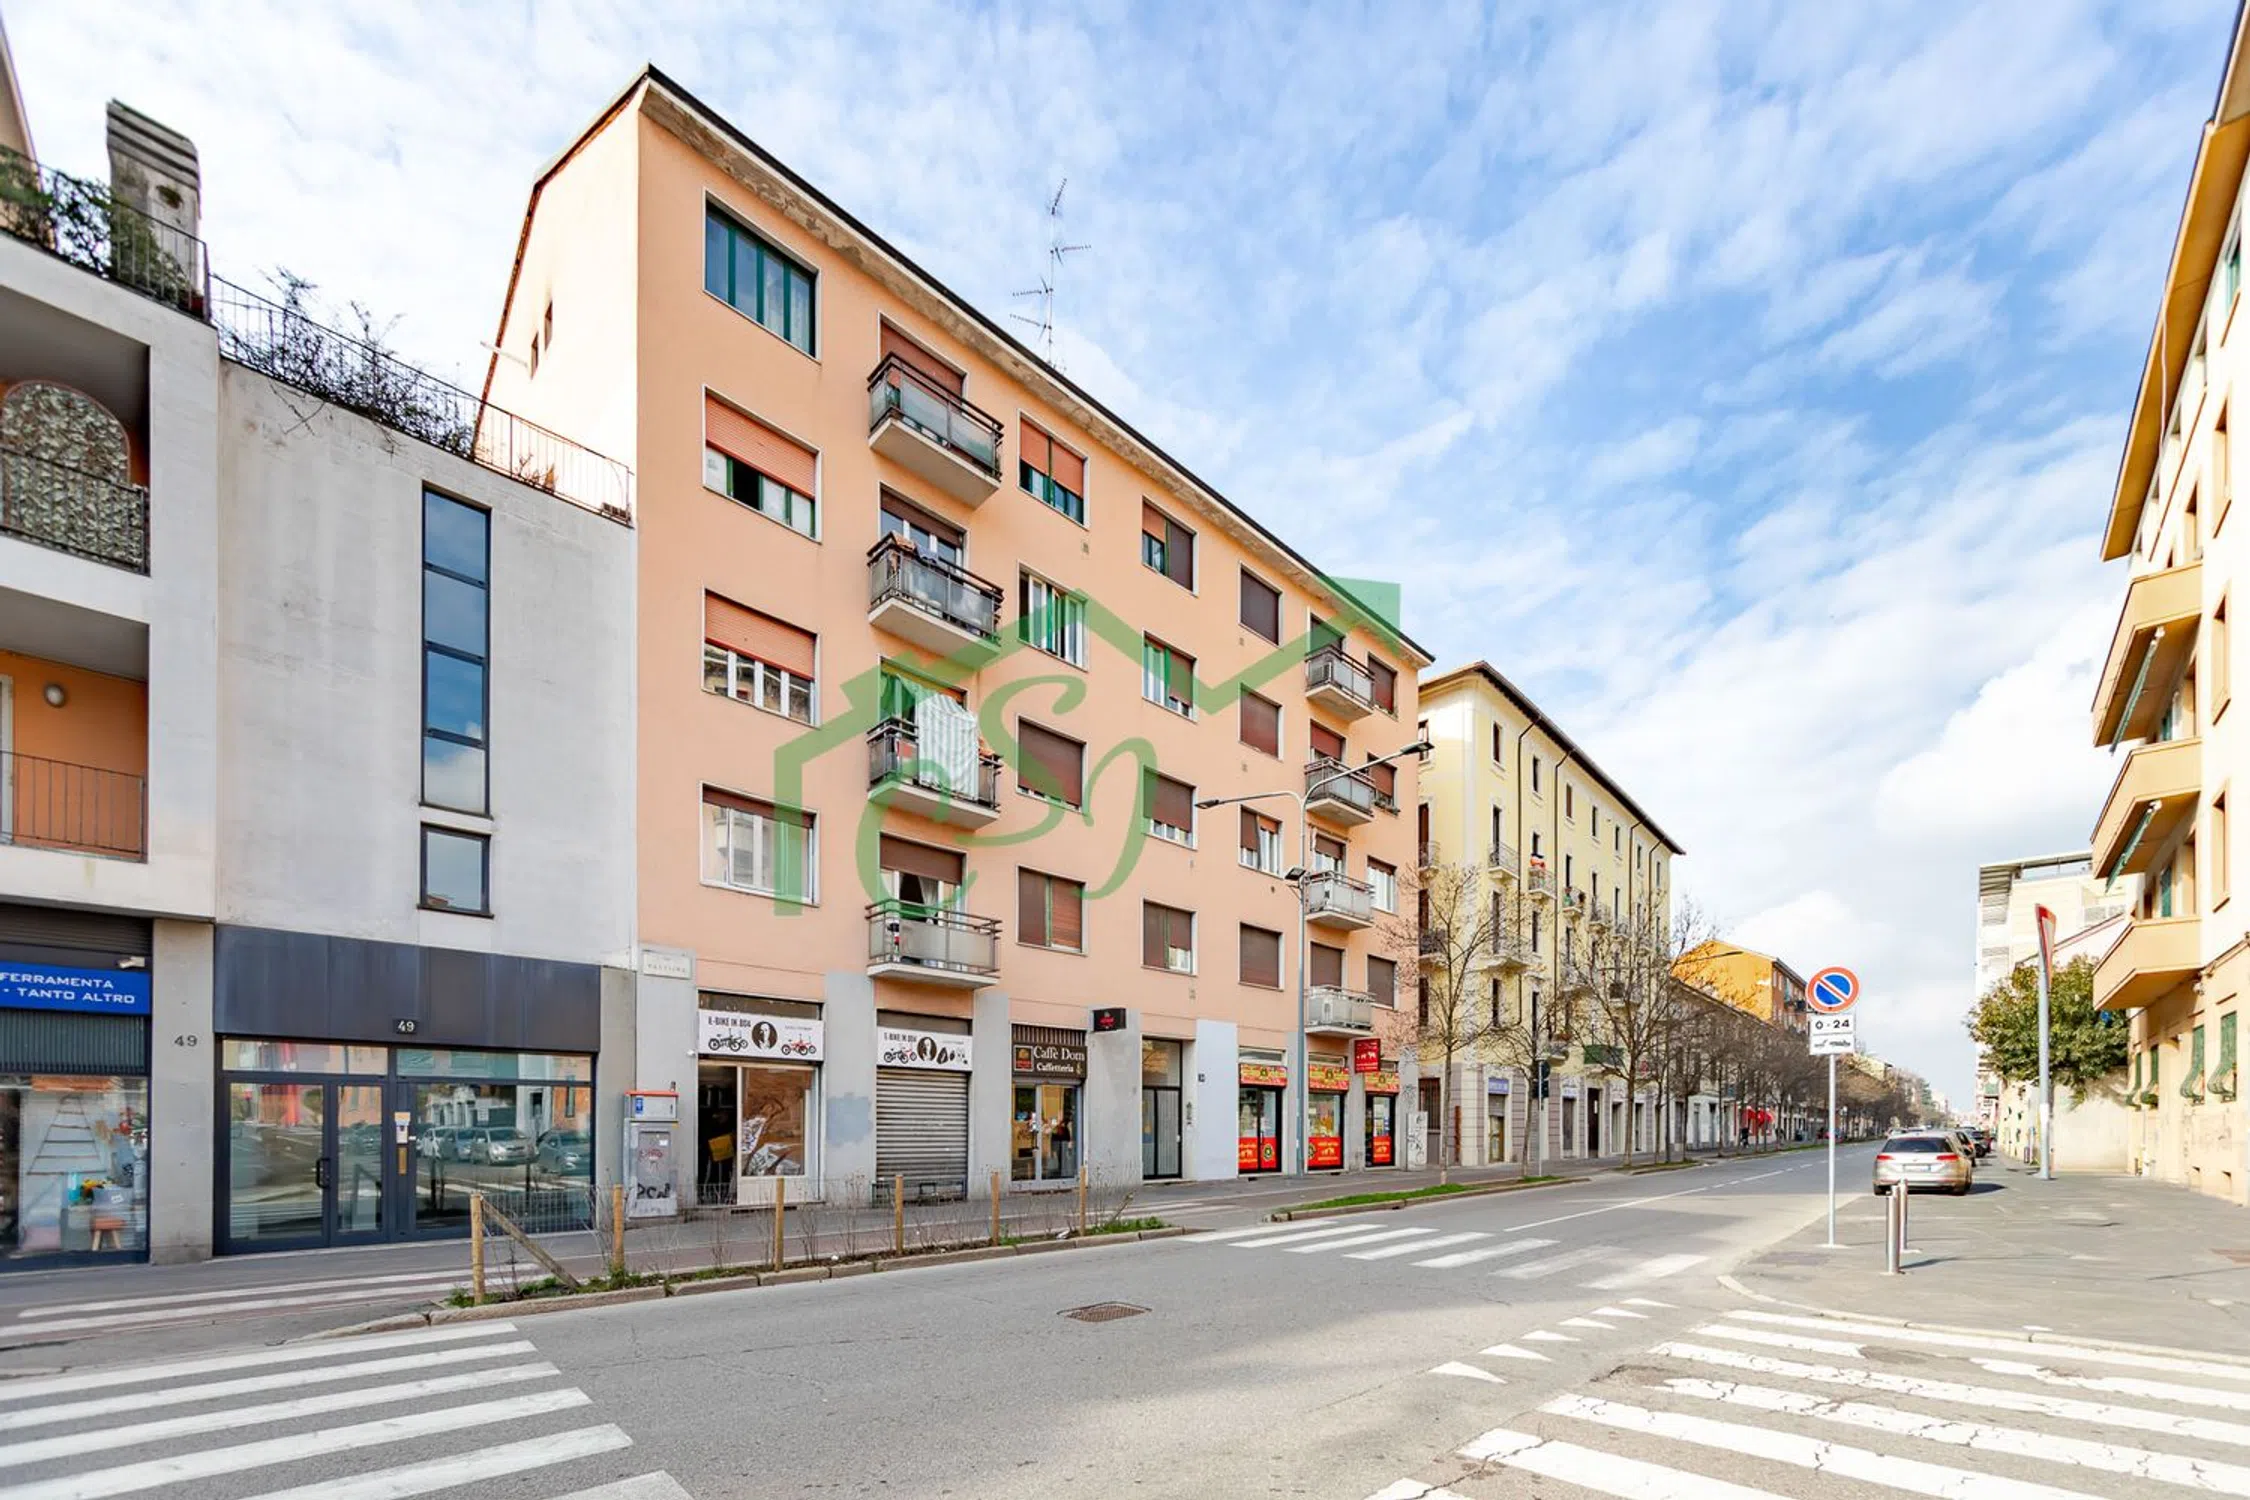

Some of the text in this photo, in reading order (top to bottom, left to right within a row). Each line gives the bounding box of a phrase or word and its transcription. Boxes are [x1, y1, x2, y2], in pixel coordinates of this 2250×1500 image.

[0, 971, 114, 989] FERRAMENTA
[17, 987, 75, 1000] TANTO
[82, 992, 135, 1004] ALTRO
[398, 1020, 415, 1032] 49
[174, 1035, 197, 1047] 49
[1036, 1062, 1074, 1073] Caffetteria
